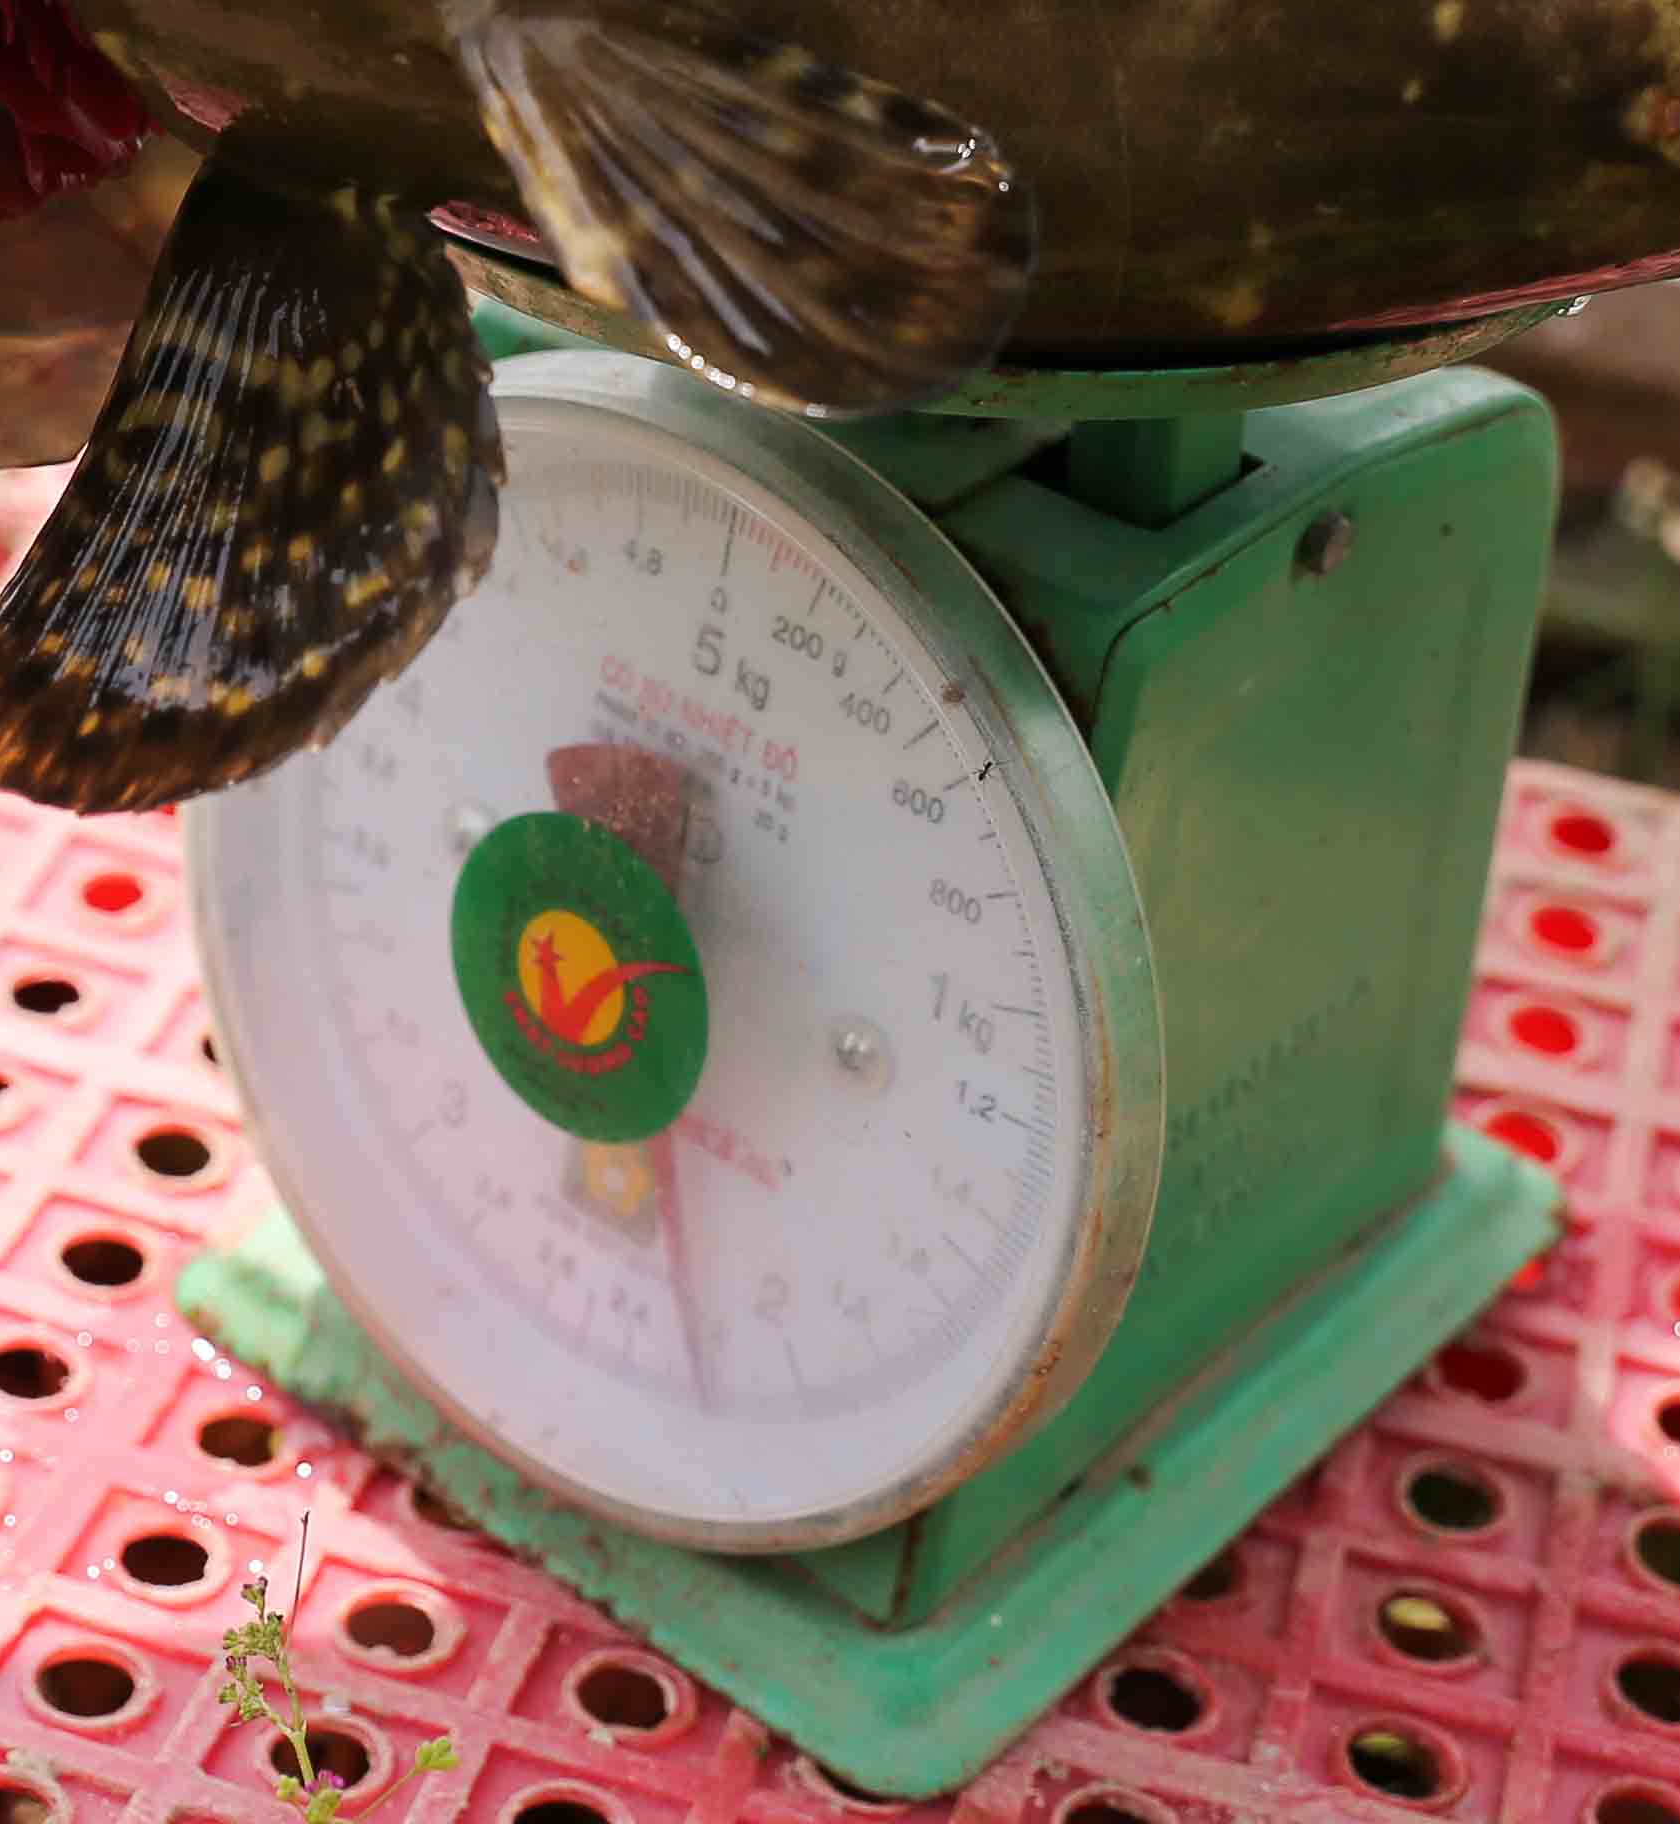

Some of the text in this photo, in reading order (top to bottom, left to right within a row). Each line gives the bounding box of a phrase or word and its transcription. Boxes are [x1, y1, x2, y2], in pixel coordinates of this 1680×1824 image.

[693, 623, 771, 711] 5 kg
[771, 614, 847, 679] 200 g
[838, 691, 891, 736] 400
[891, 779, 945, 825] 600
[930, 878, 982, 925] 800
[931, 971, 996, 1055] 1 kg
[955, 1078, 998, 1123] 1.2
